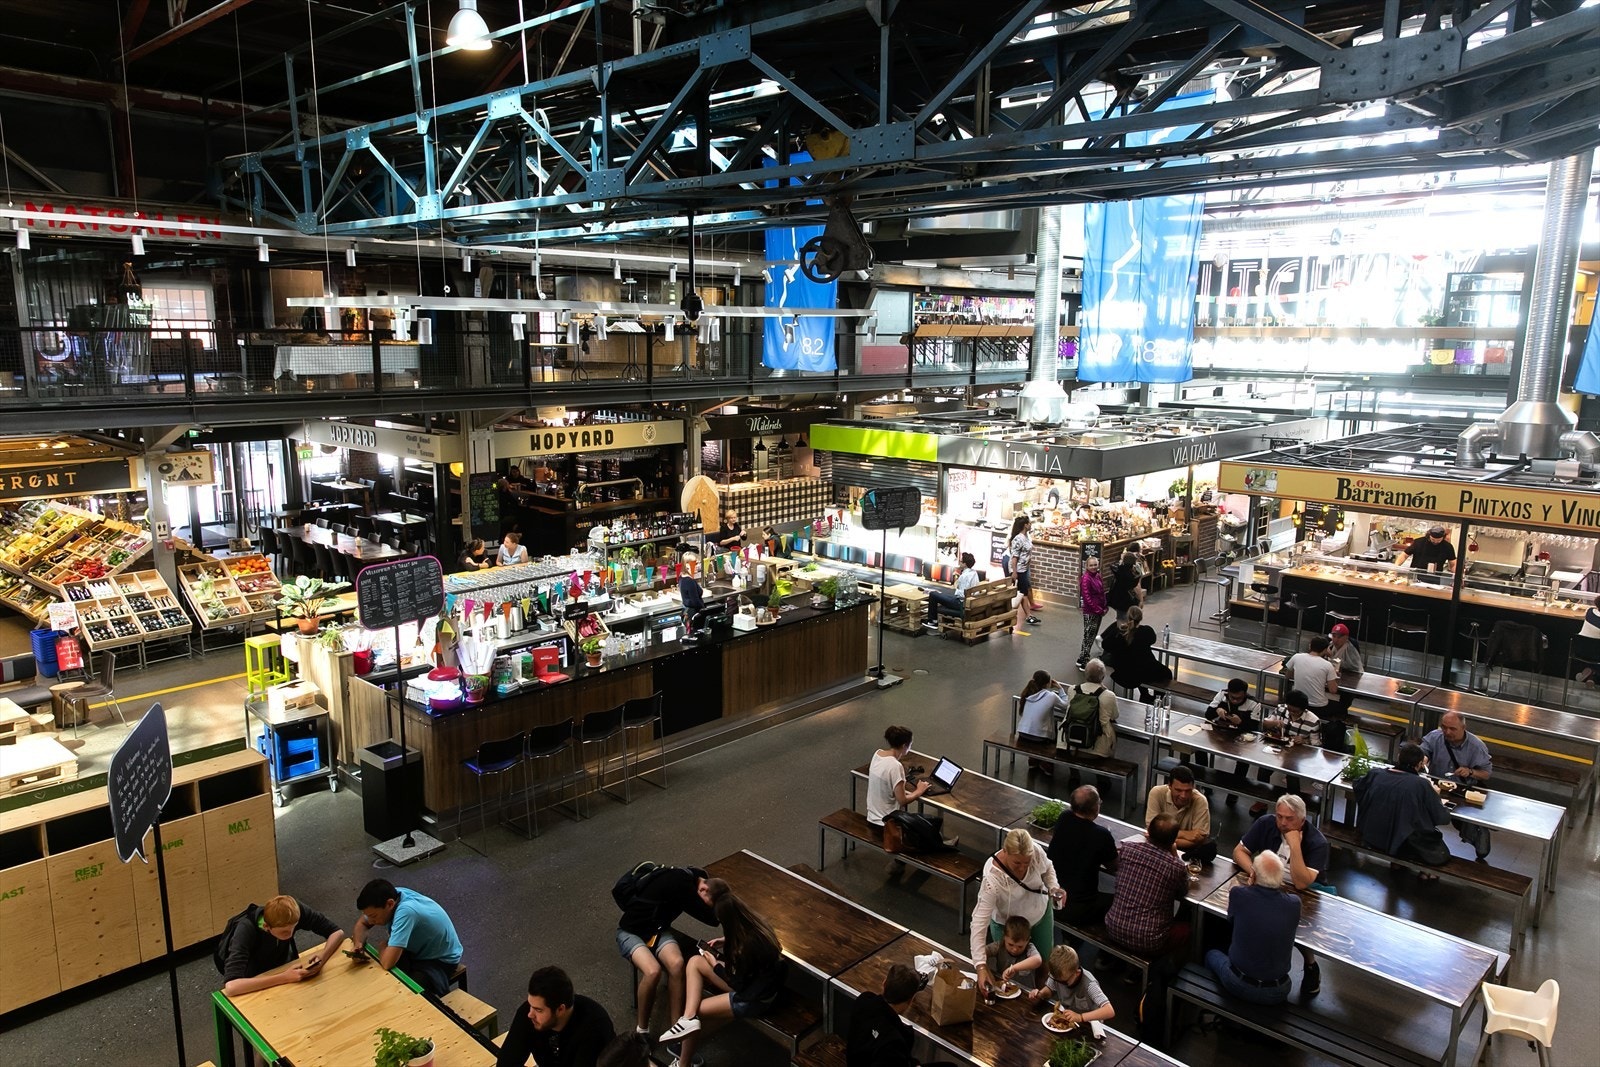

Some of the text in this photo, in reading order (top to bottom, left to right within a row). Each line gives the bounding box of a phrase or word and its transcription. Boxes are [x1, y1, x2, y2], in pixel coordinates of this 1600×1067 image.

[24, 201, 222, 239] MATSALEN
[746, 415, 782, 432] Mildrids
[330, 425, 377, 448] HOPYARD
[530, 429, 614, 451] HOPYARD
[970, 443, 1063, 474] VIA ITALIA
[1172, 439, 1218, 465] VIA ITALIA
[1334, 477, 1437, 510] Barramón
[228, 818, 250, 832] MAT
[154, 839, 184, 854] APIR
[75, 862, 105, 877] REST
